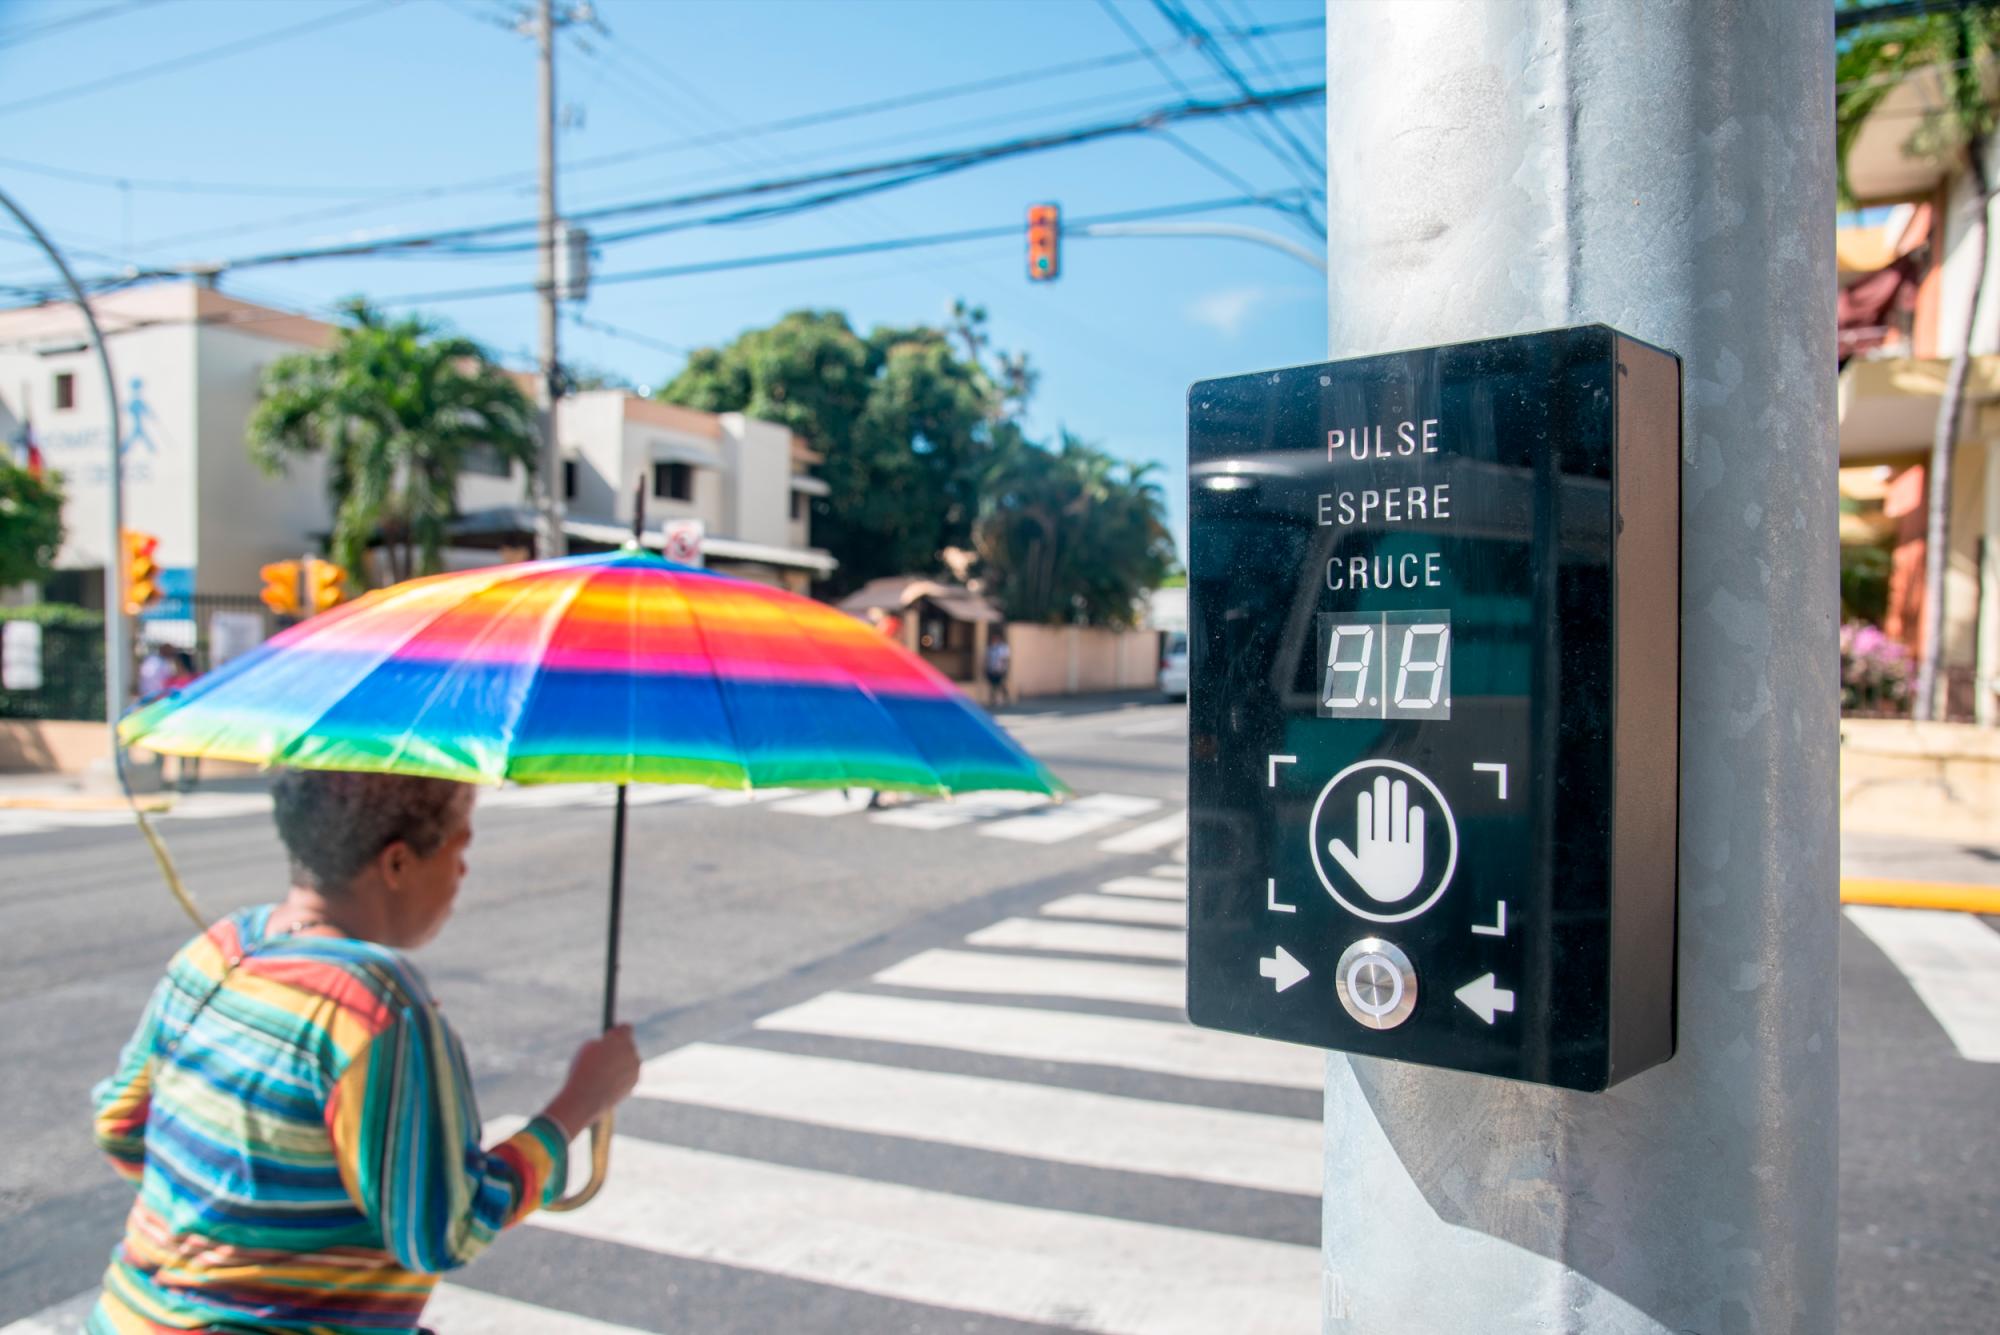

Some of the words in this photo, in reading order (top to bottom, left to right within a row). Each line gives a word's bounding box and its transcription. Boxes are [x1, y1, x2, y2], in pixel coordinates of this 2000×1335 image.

[1327, 419, 1439, 463] PULSE
[1317, 484, 1450, 526] ESPERE
[1326, 552, 1441, 591] CRUCE
